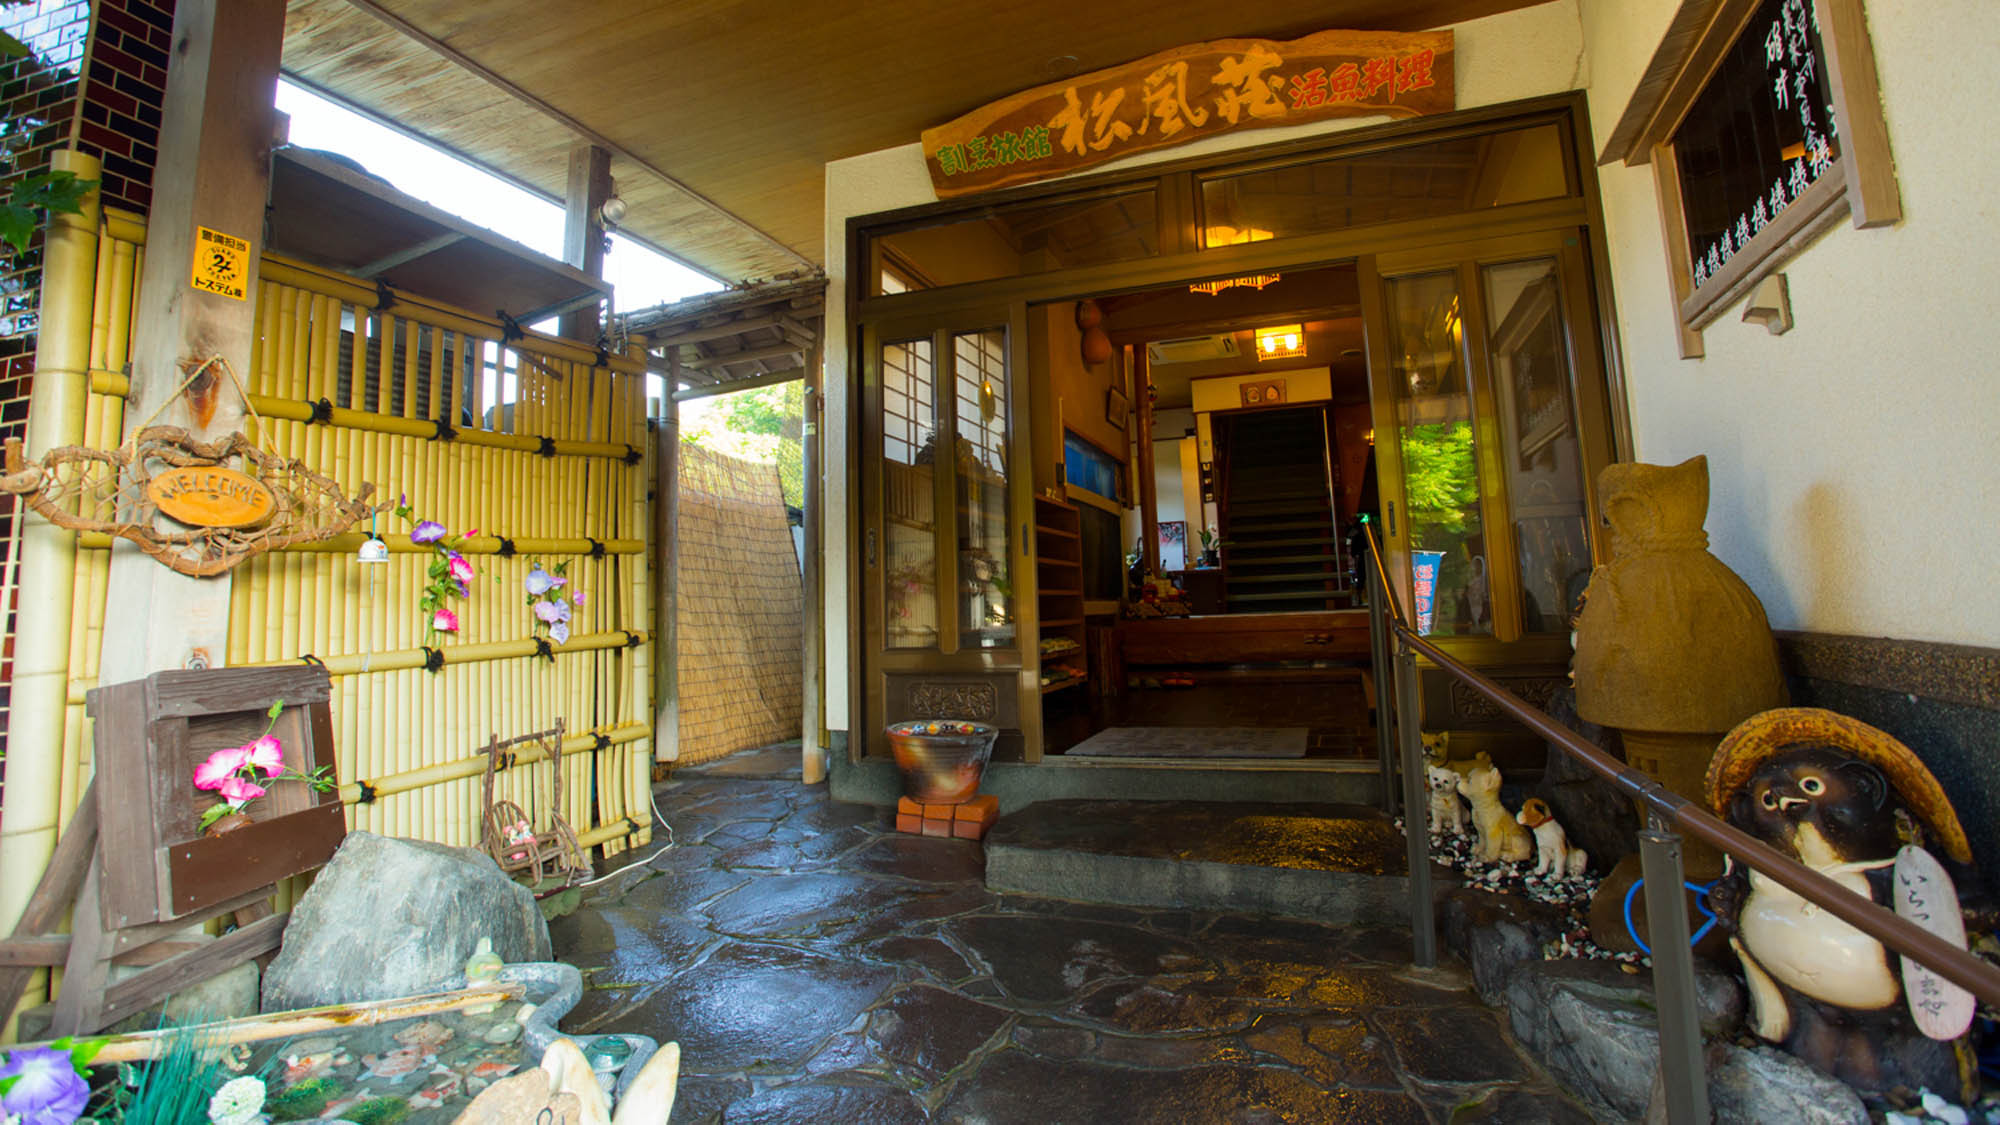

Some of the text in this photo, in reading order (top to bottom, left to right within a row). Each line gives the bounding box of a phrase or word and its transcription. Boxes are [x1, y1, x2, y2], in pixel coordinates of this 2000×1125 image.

[936, 125, 1052, 176] 割烹旅館
[1289, 49, 1435, 109] 活魚料理
[161, 473, 264, 506] WELCOME
